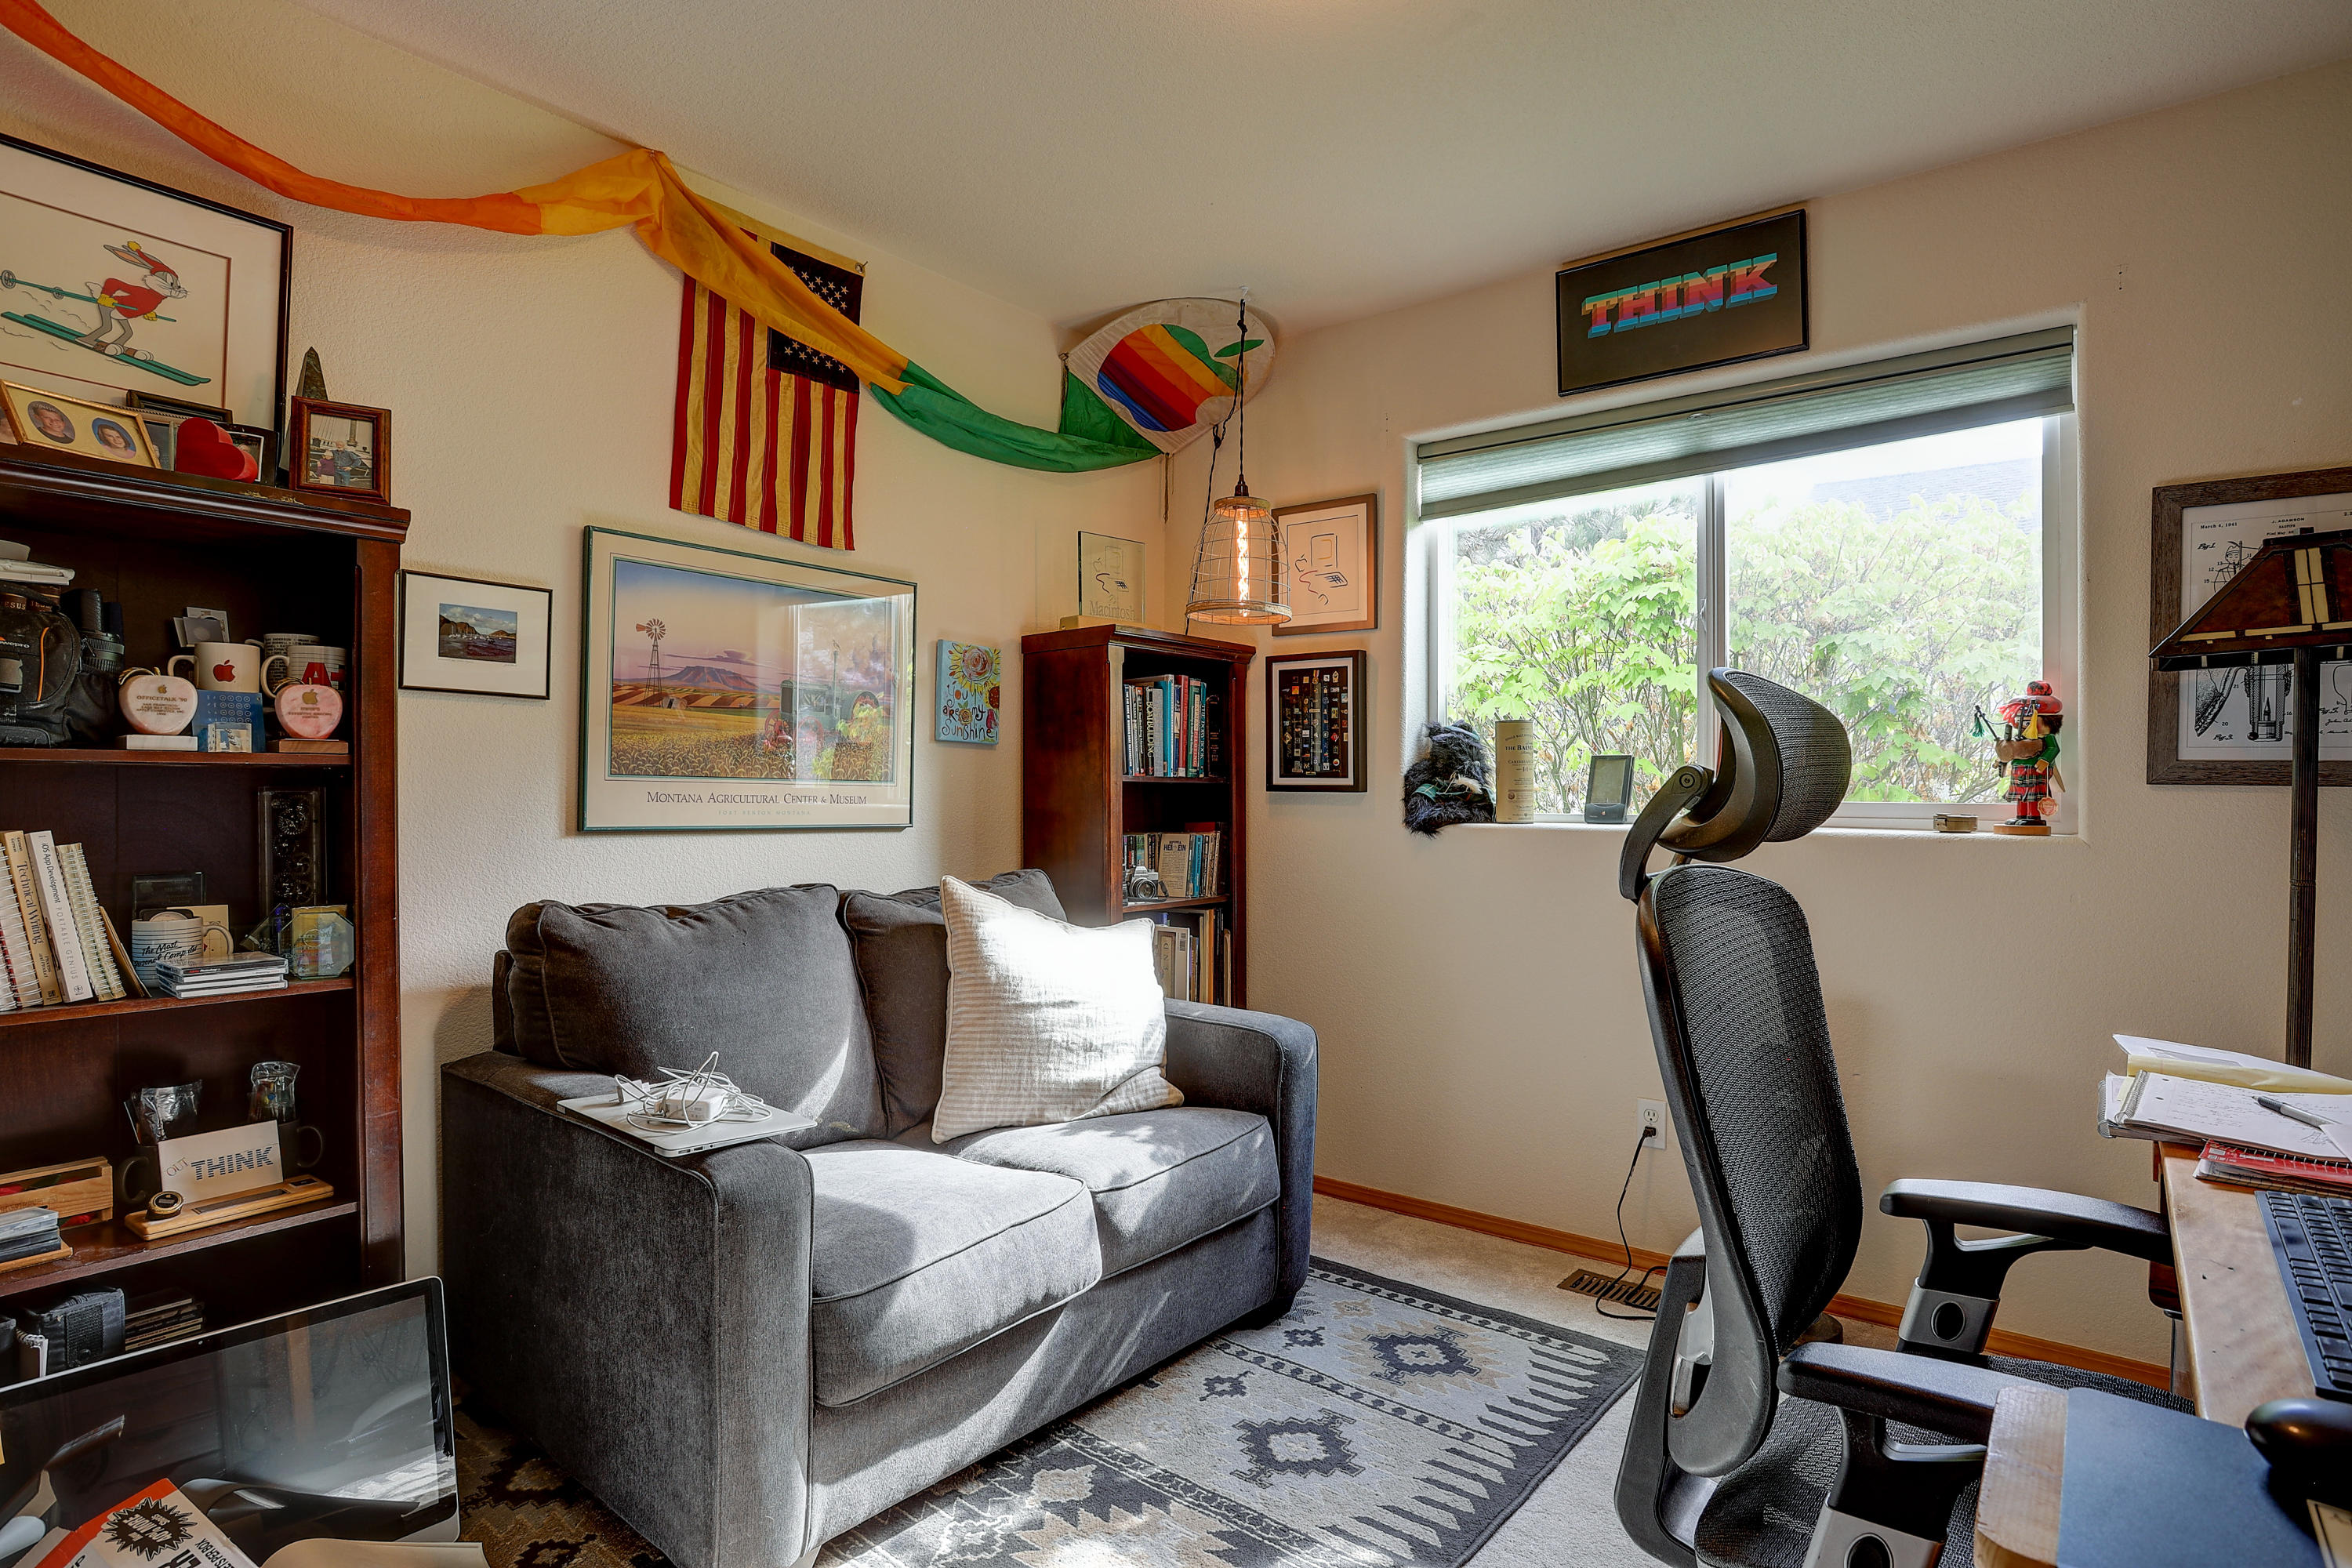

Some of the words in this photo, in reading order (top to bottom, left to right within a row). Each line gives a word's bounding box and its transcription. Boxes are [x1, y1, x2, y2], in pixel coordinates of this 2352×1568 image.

[1581, 252, 1778, 339] THINK
[1089, 601, 1136, 621] Macintosh
[972, 704, 986, 721] my
[647, 791, 703, 803] MONTANA
[707, 792, 780, 804] AGRICULTURAL
[784, 793, 817, 804] CENTER
[829, 794, 867, 804] MUSEUM
[17, 861, 37, 909] Technical
[28, 908, 44, 945] Writing
[41, 843, 50, 854] iOS
[46, 866, 61, 903] Development
[56, 907, 71, 946] PORTABLE
[65, 950, 78, 980] GENIUS
[142, 946, 154, 956] The
[157, 941, 178, 953] Most
[166, 1157, 189, 1176] OUT
[191, 1146, 273, 1180] THINK
[123, 1514, 157, 1533] MORE
[145, 1526, 172, 1542] 40%
[195, 1538, 213, 1553] BOX
[205, 1548, 223, 1563] PER
